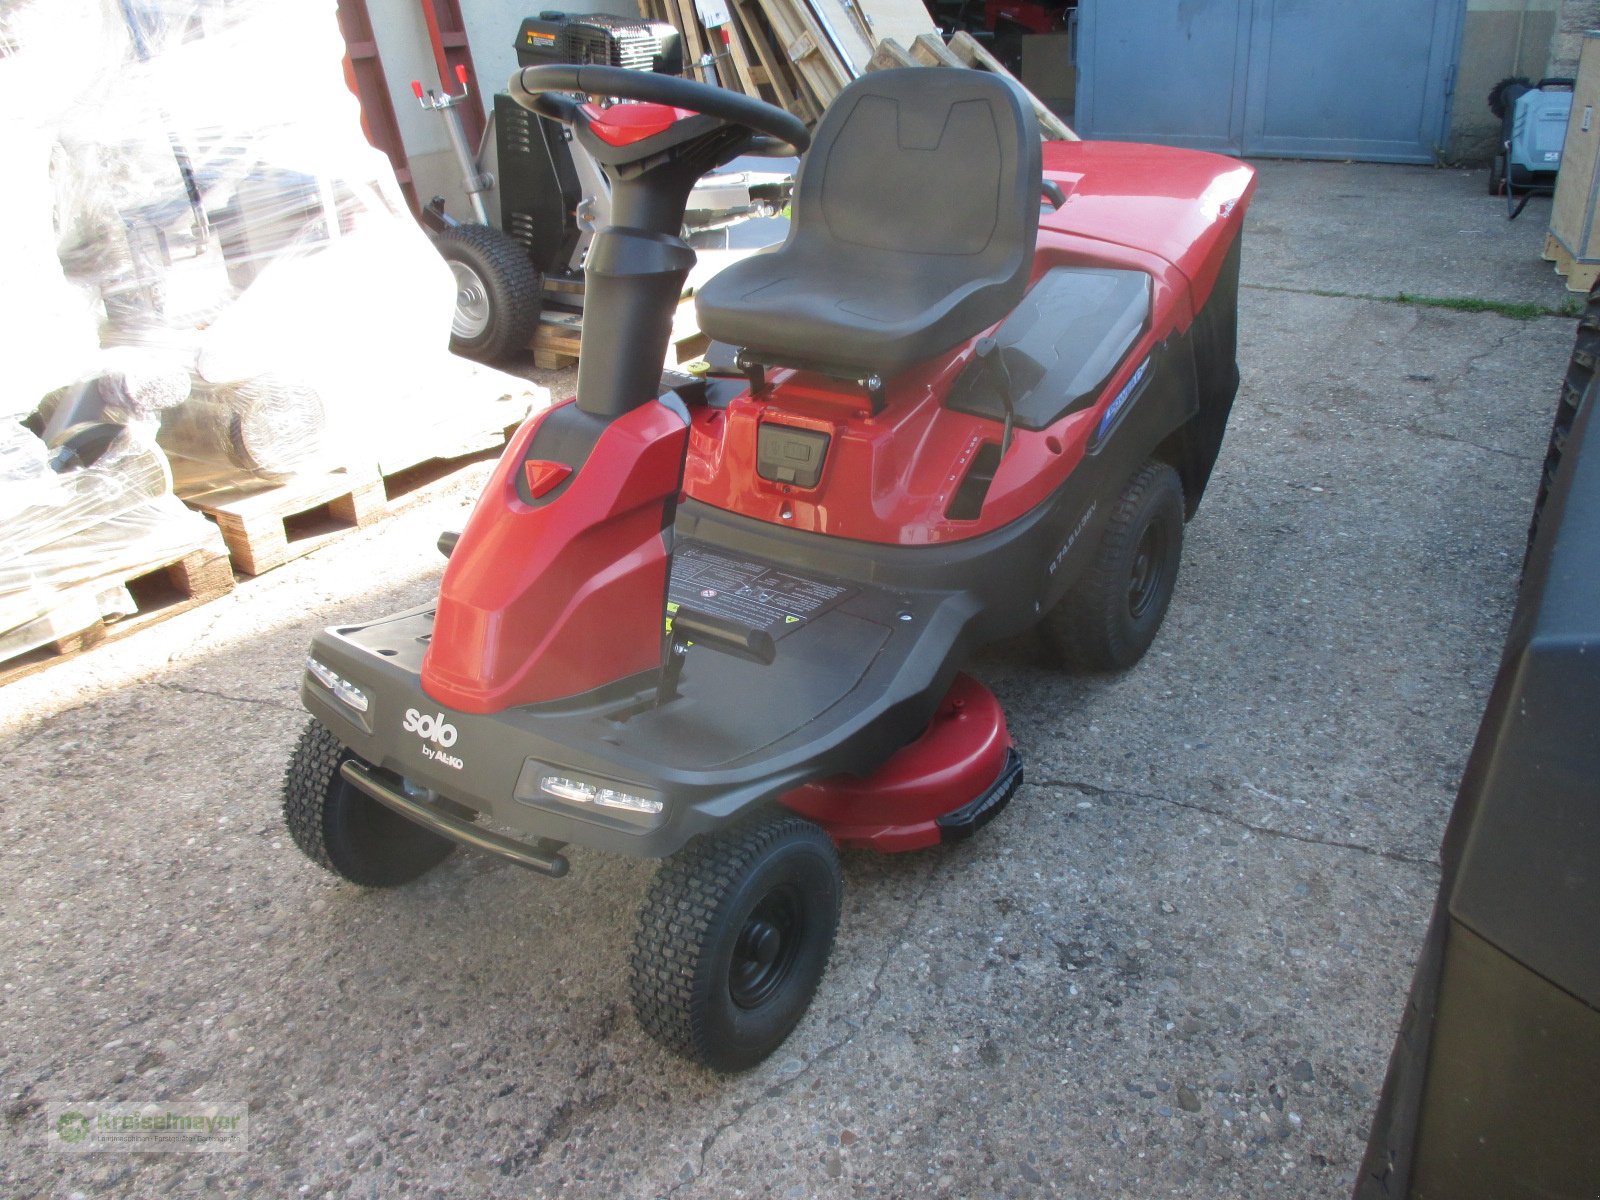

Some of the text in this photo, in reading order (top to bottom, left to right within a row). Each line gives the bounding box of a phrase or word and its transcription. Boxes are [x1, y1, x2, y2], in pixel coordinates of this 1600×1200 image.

[402, 708, 458, 748] solo
[422, 744, 464, 770] by AL-KO
